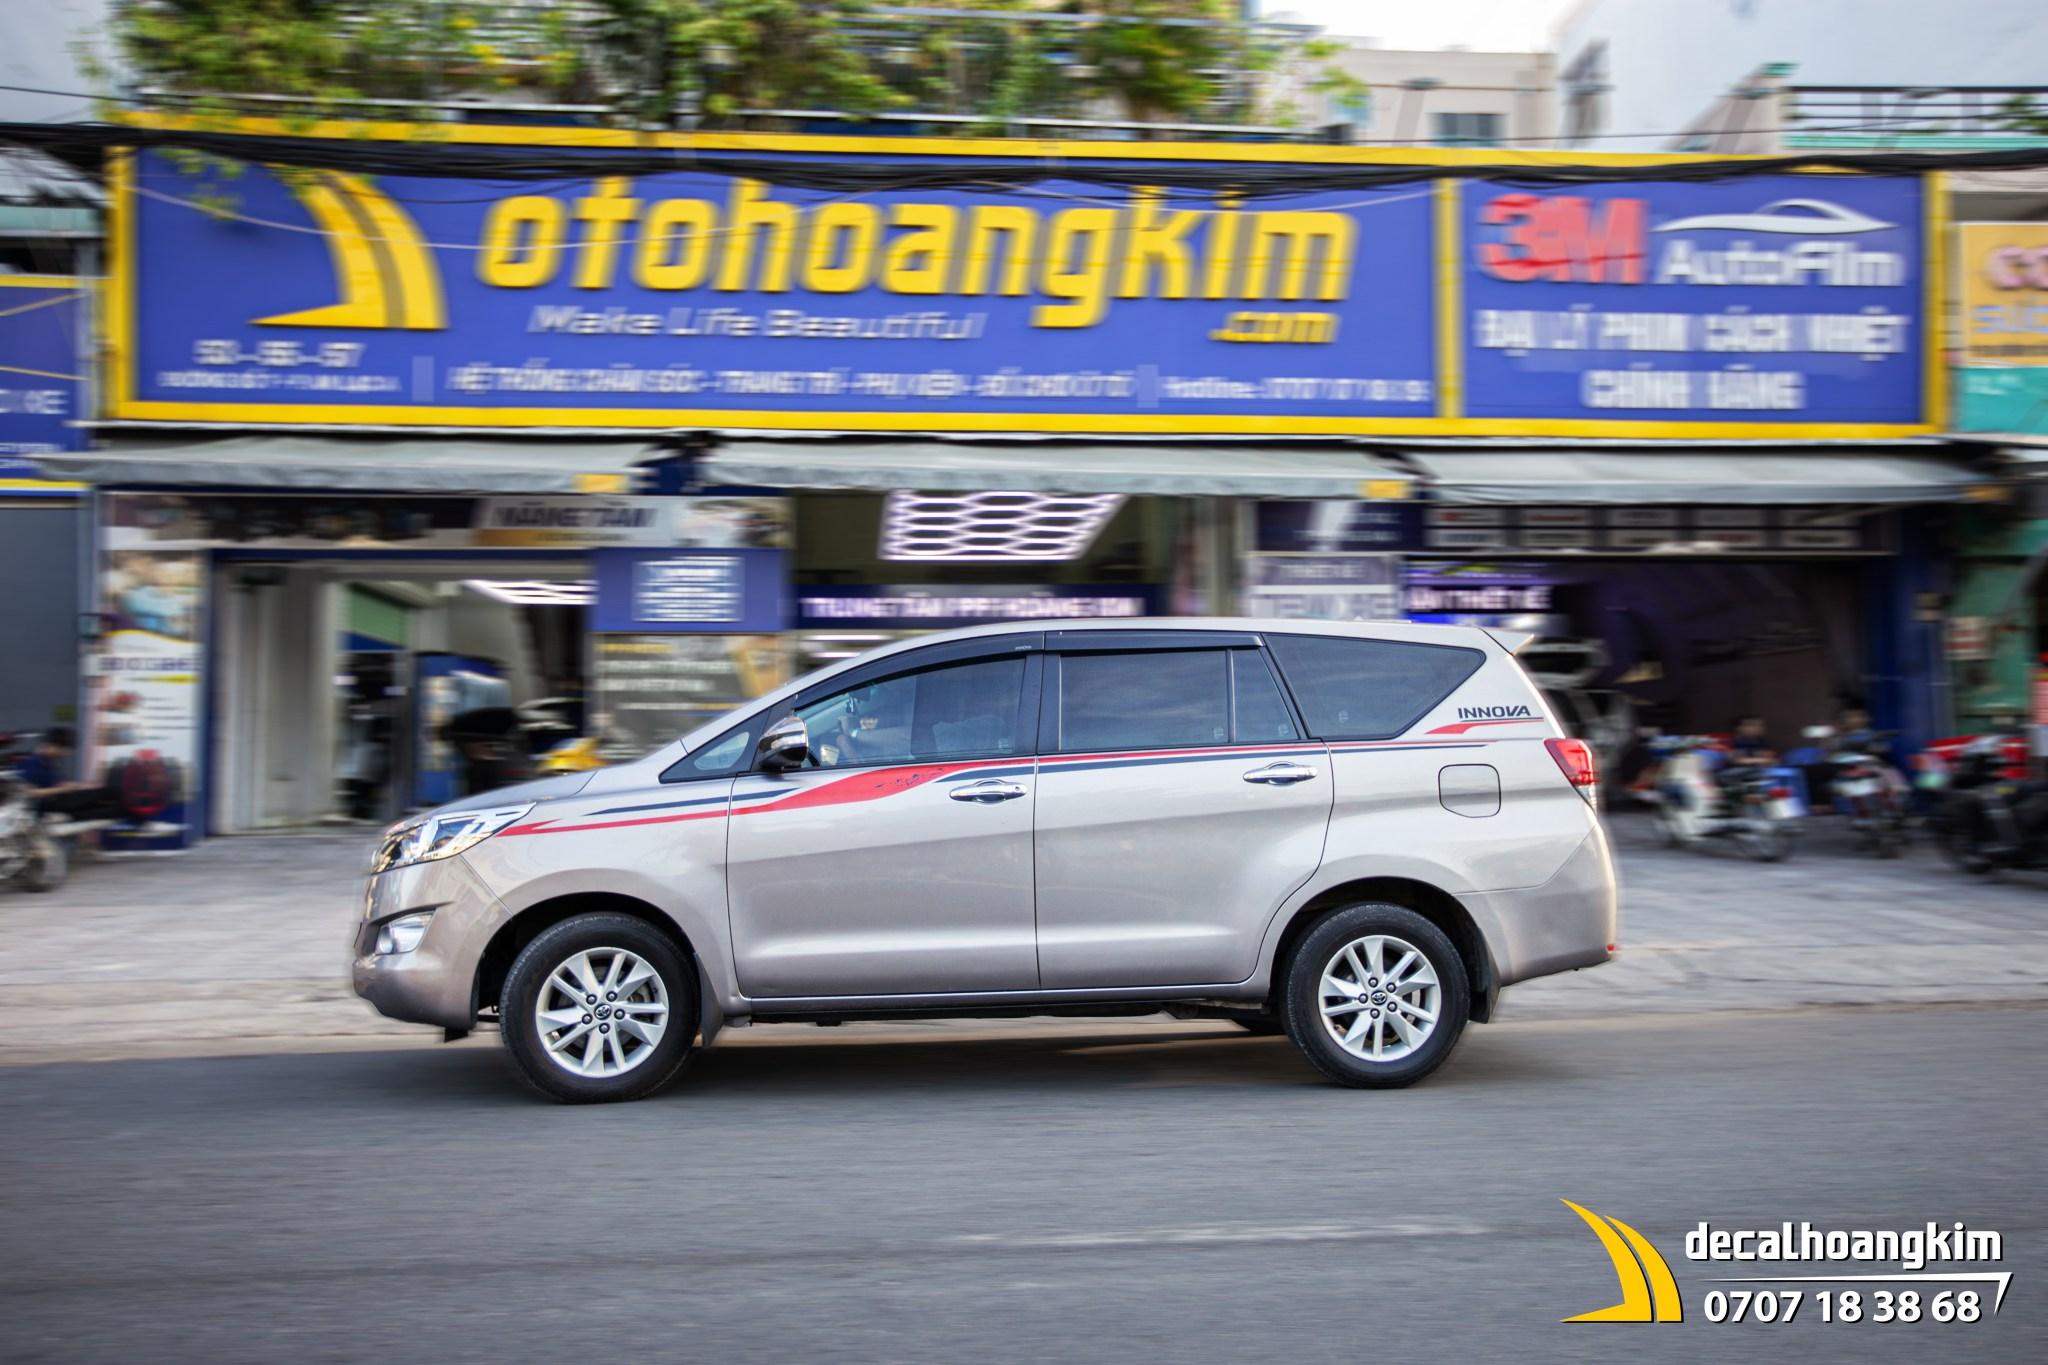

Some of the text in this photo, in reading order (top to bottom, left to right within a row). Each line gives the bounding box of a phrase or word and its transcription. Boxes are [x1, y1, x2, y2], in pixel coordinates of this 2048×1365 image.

[478, 173, 1358, 328] otohoangkim
[1476, 192, 1647, 285] 3M
[1655, 239, 1902, 286] AutoFilm
[530, 304, 984, 340] Make Life Beautiful
[1457, 705, 1532, 720] INNOVA
